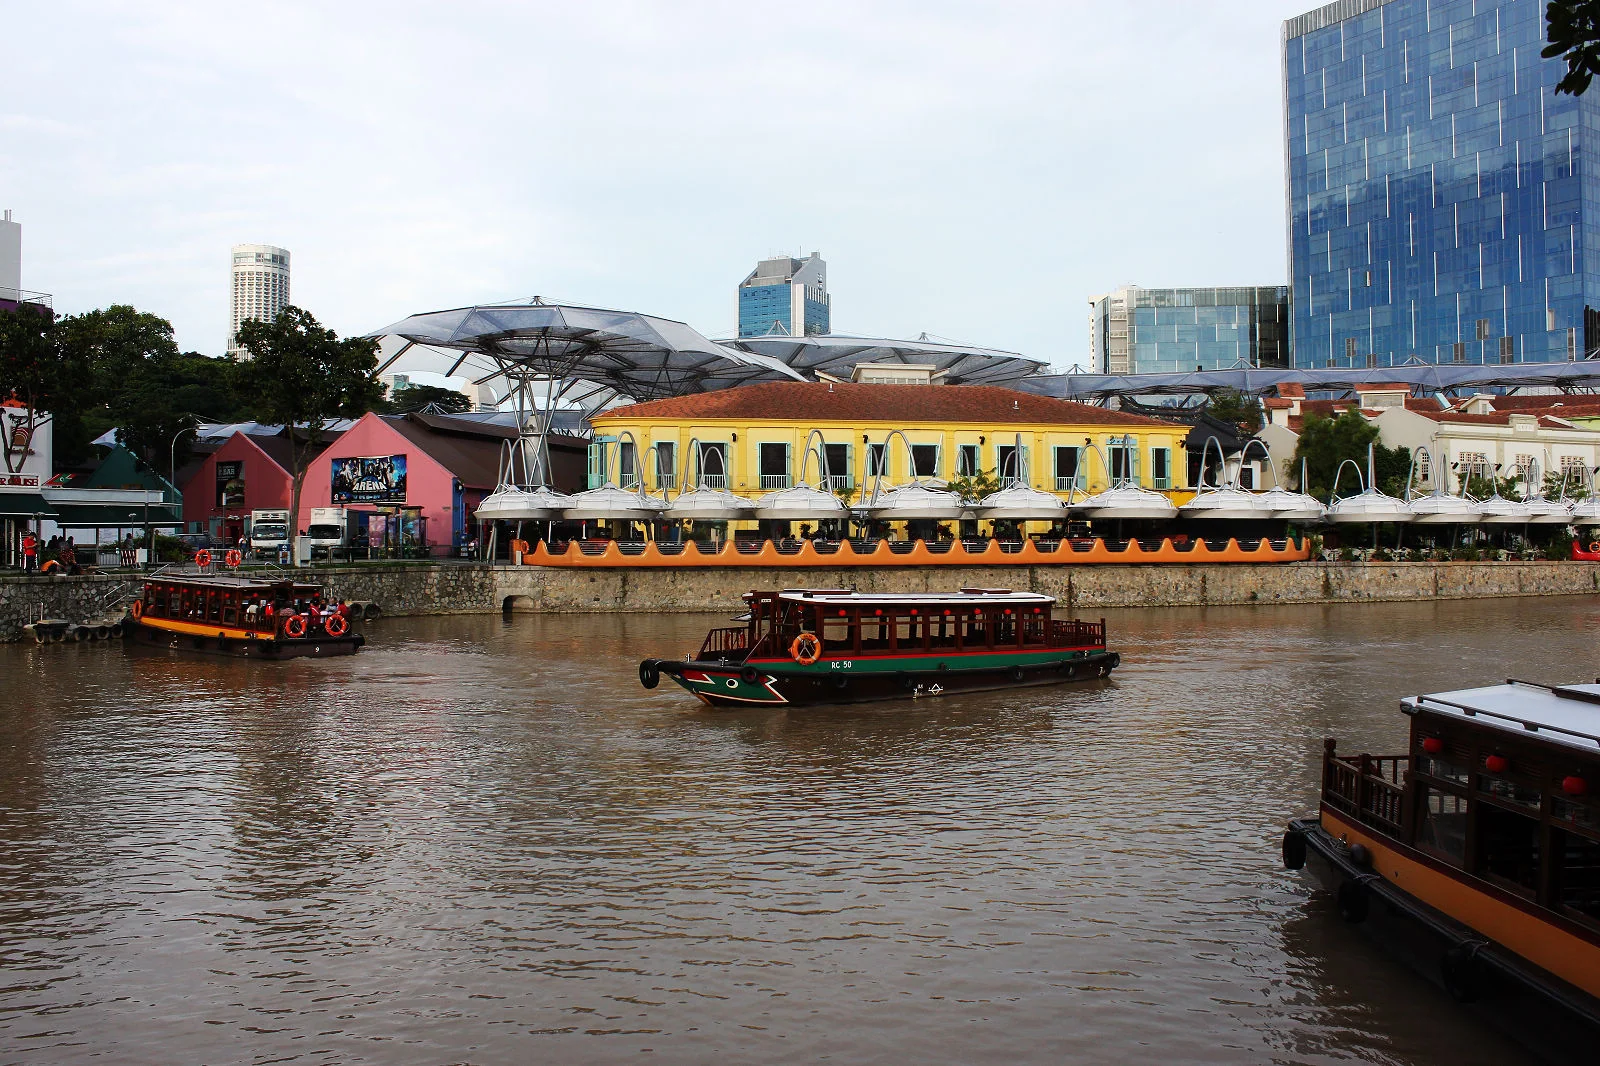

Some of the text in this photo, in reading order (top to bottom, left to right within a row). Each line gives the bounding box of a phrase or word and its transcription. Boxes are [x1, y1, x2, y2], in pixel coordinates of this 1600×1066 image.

[352, 480, 387, 491] ARENA
[831, 660, 852, 669] RC 50
